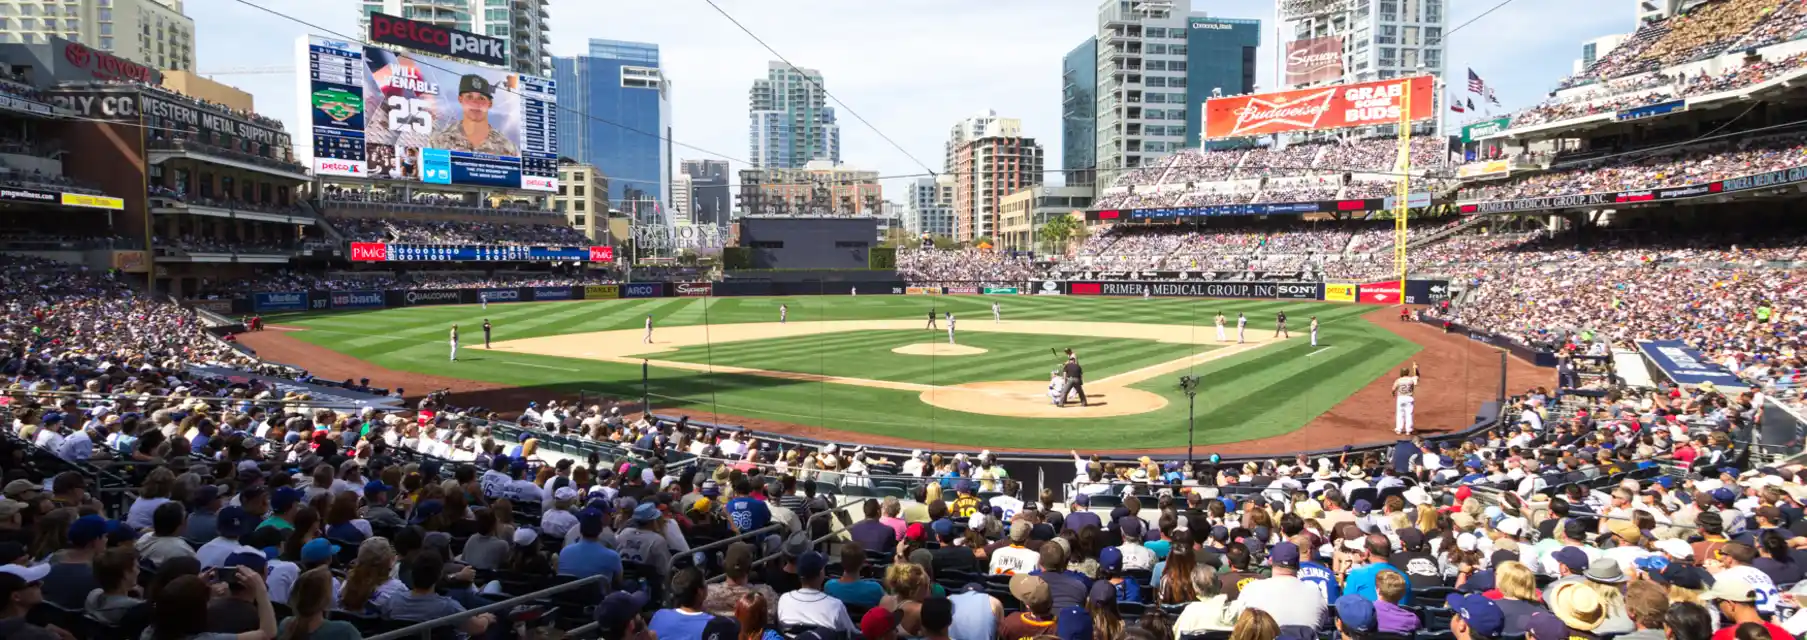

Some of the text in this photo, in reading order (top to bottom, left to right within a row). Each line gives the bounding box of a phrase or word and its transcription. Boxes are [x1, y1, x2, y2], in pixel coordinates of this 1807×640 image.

[374, 15, 503, 59] petco park
[1287, 48, 1338, 67] Sycuan
[93, 52, 152, 81] TOYOTA
[391, 64, 418, 79] WILL
[384, 75, 439, 95] VENABLE
[1345, 84, 1400, 100] GRAB
[1355, 98, 1391, 107] SOME
[388, 96, 432, 135] 25
[1233, 102, 1330, 122] Budweiser
[1346, 106, 1400, 122] BUDS
[141, 95, 198, 125] WESTERN
[202, 112, 237, 136] METAL
[239, 123, 274, 145] SUPPLY
[322, 162, 349, 171] petco
[1477, 202, 1511, 212] PRIMERA
[1514, 199, 1551, 210] MEDICAL
[406, 291, 458, 303] QUALCOMM
[479, 290, 518, 299] GEICO
[627, 285, 652, 295] ARCO
[1104, 284, 1149, 295] PRIMER
[1153, 284, 1204, 296] MEDICAL
[1207, 284, 1250, 297] GROUP,
[1278, 285, 1316, 294] SONY
[313, 299, 327, 309] 357
